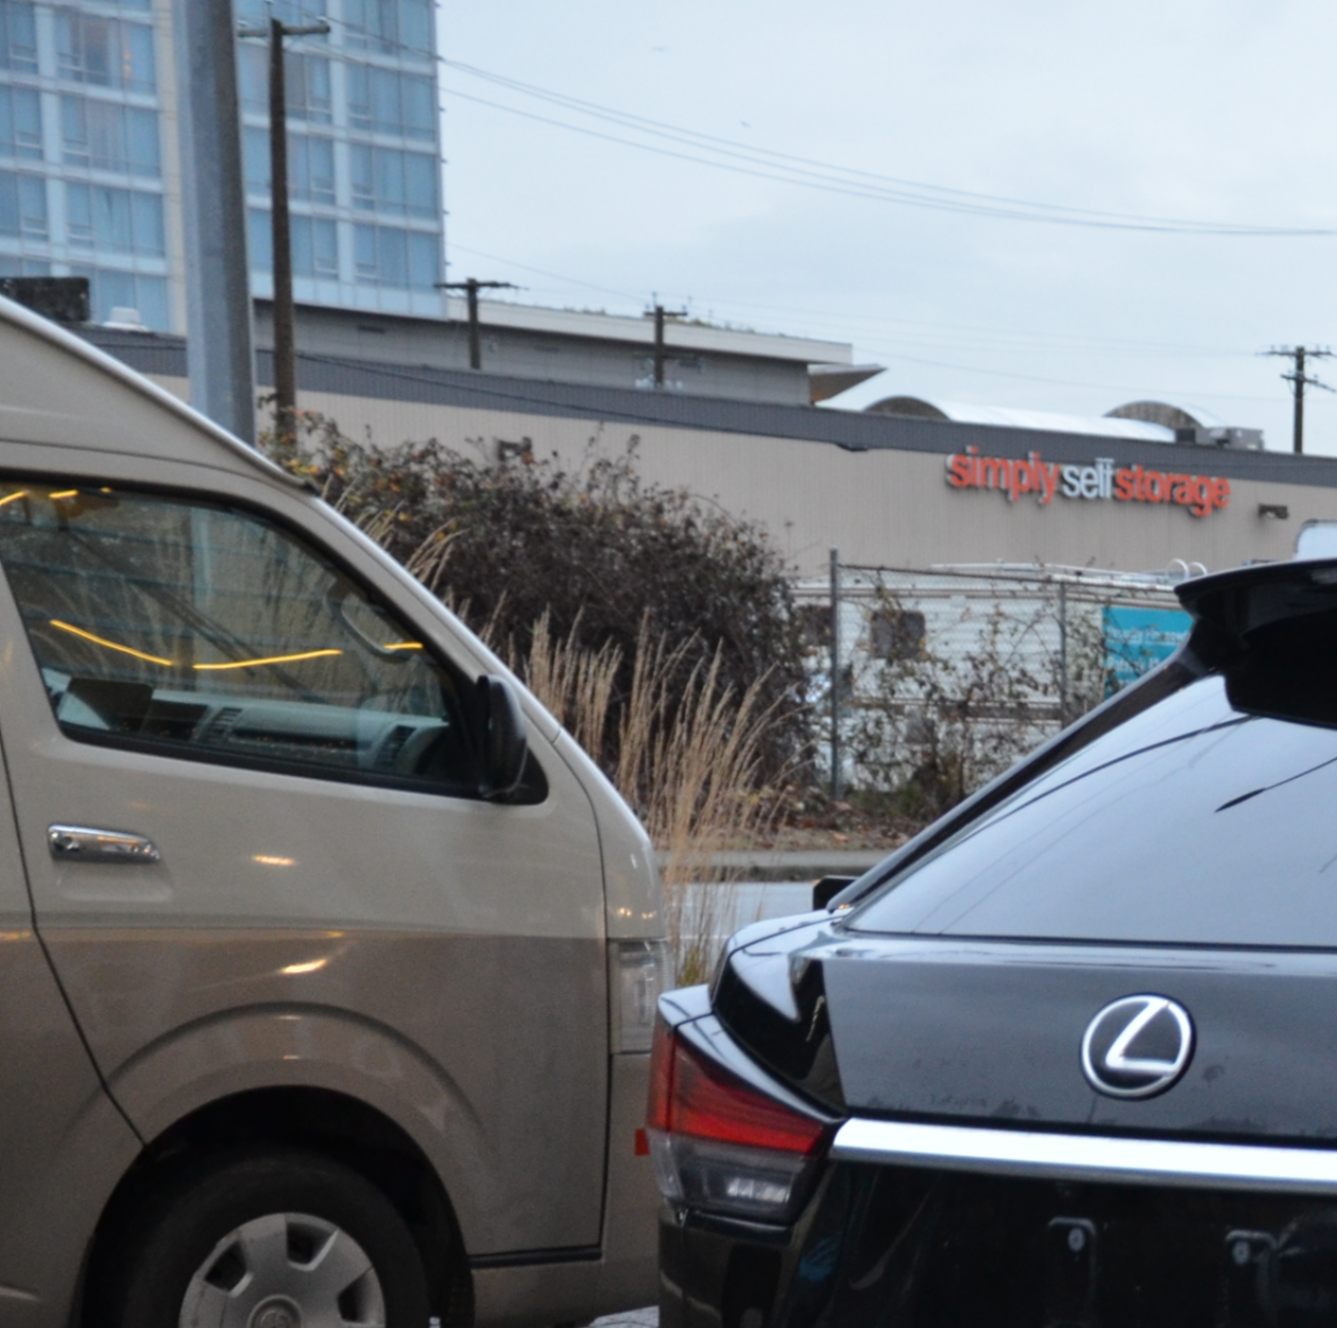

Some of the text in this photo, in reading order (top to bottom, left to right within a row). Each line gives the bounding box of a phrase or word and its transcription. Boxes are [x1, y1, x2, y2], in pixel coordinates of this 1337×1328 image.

[946, 445, 1231, 518] simply self storage
